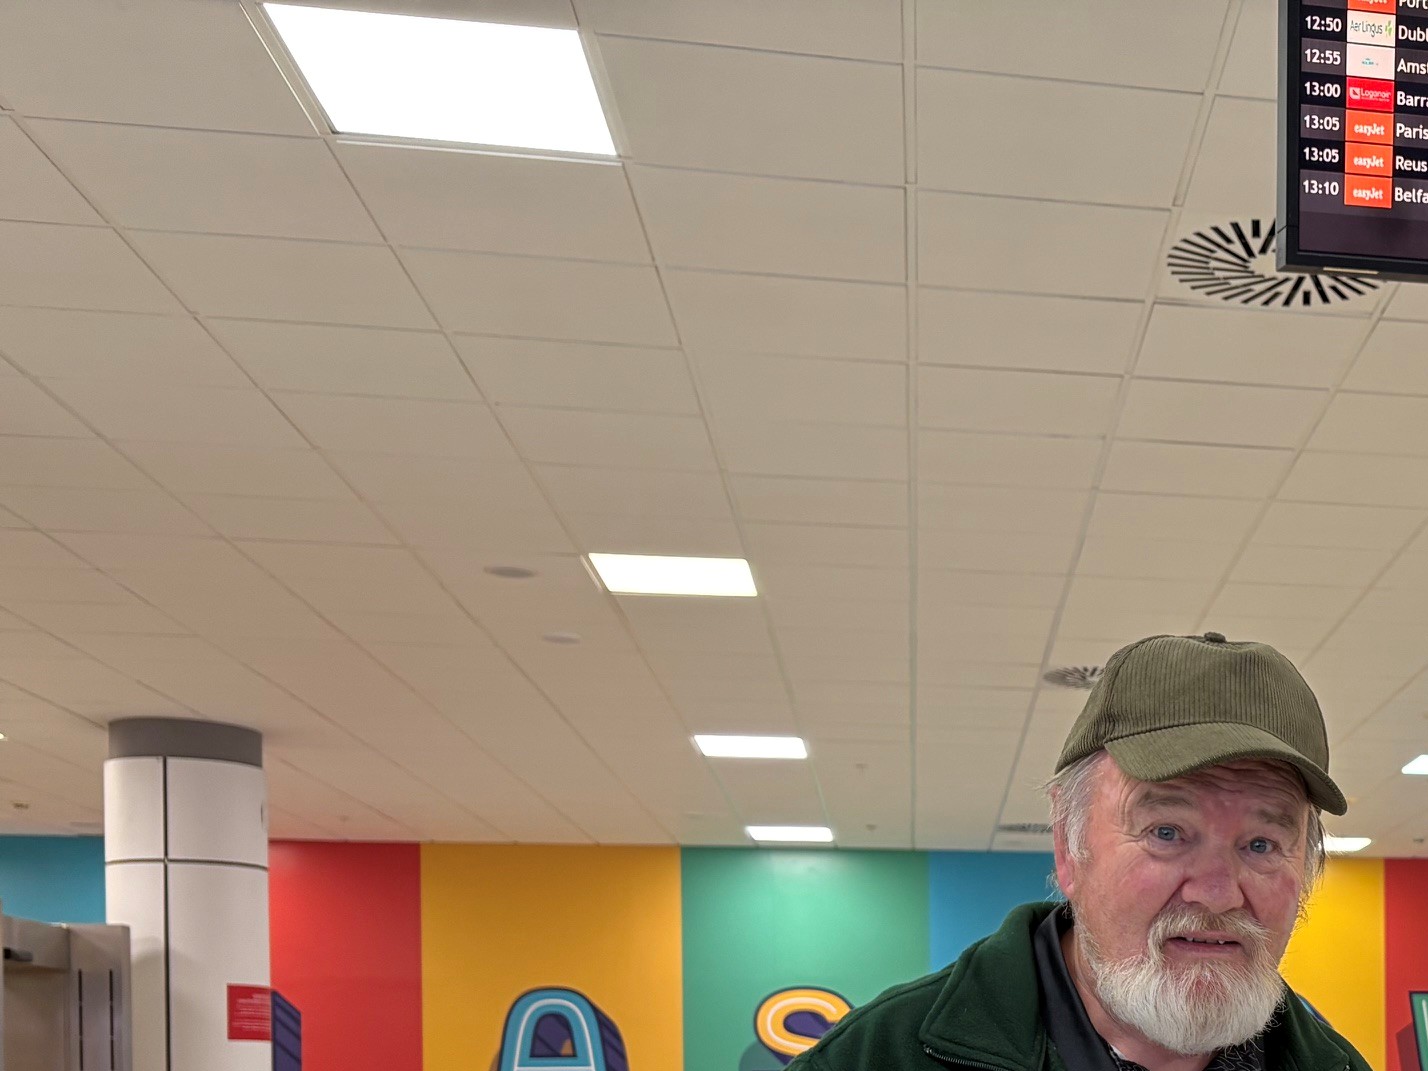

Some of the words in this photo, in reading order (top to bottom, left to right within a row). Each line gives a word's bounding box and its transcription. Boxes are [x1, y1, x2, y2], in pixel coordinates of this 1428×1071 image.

[1304, 15, 1342, 32] 12:50
[1361, 21, 1383, 37] Lingus
[1304, 49, 1341, 65] 12:55
[1304, 81, 1341, 98] 13:00
[1303, 115, 1340, 131] 13:05
[1354, 123, 1385, 136] easyJet
[1303, 147, 1339, 163] 13:05
[1353, 155, 1384, 168] easyJet
[1395, 155, 1428, 172] Reus
[1303, 179, 1339, 195] 13:10
[1353, 187, 1383, 200] easyJet
